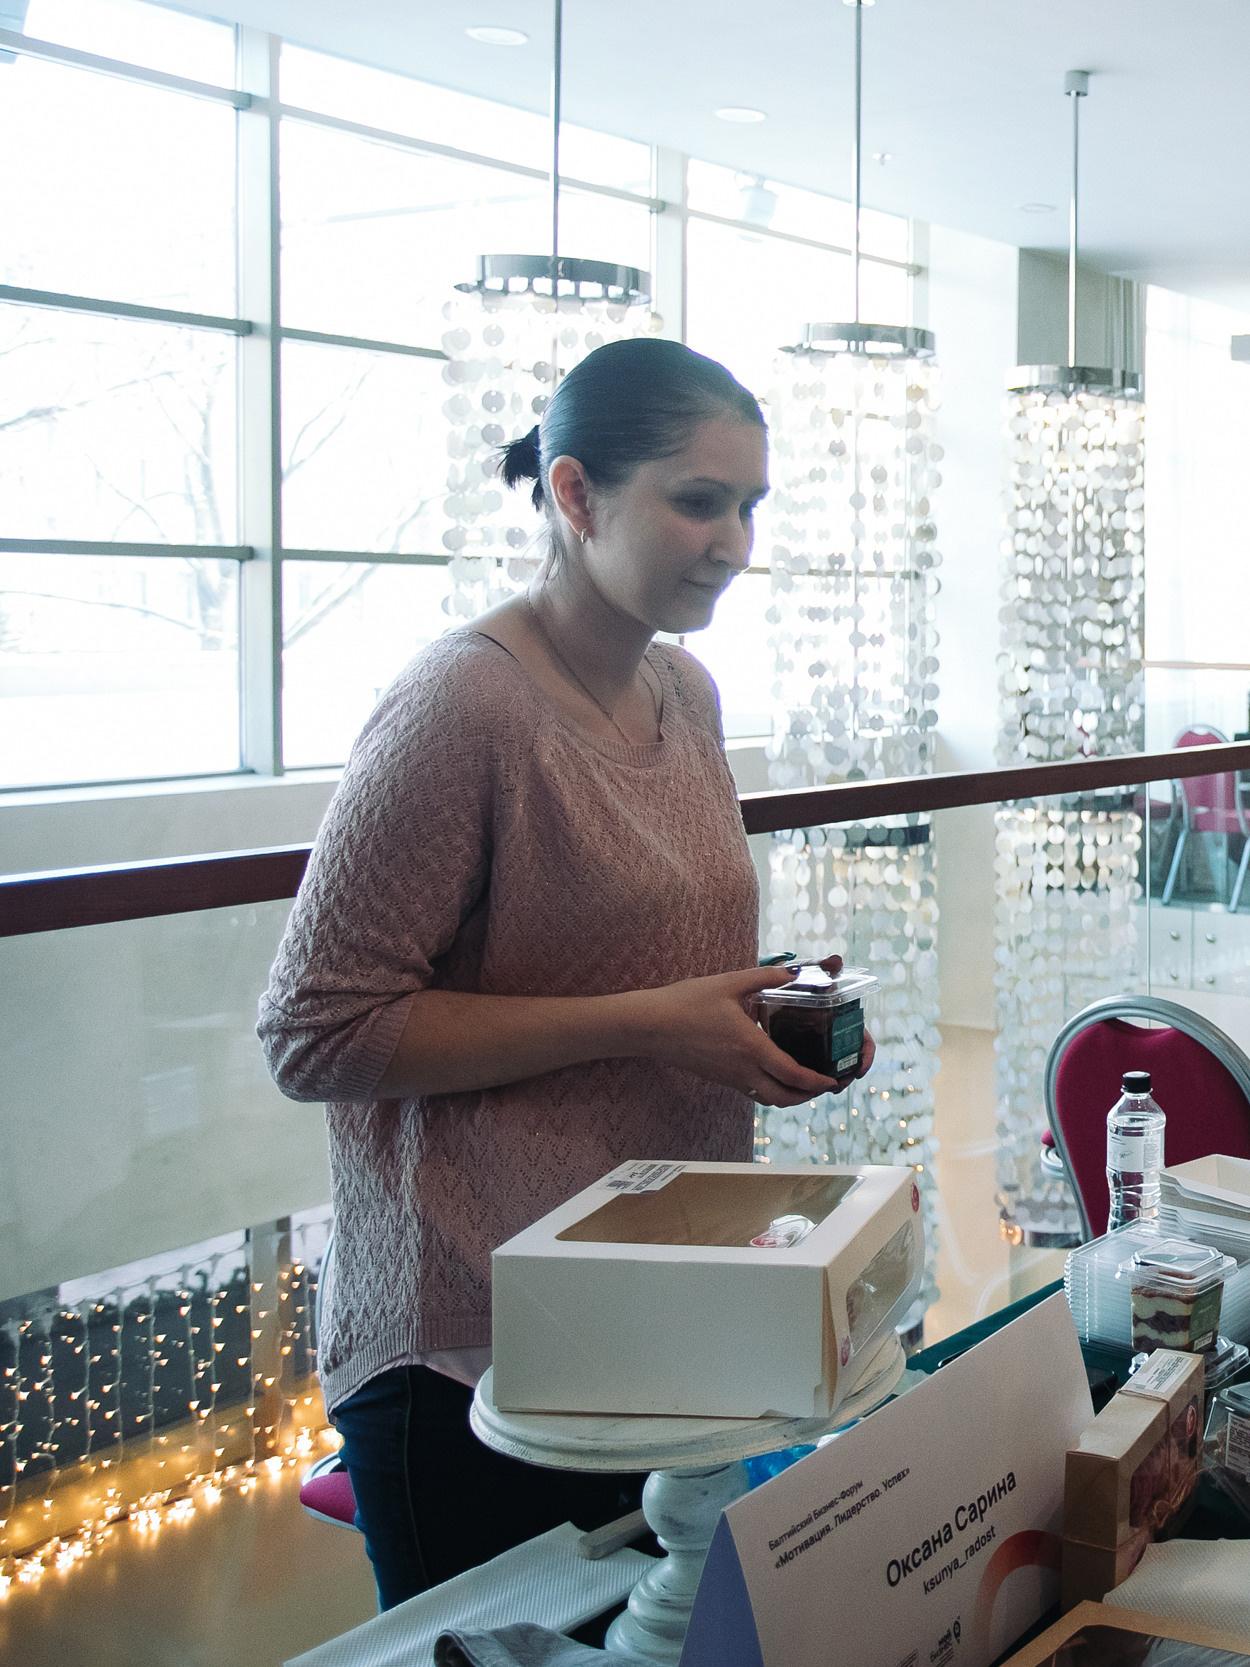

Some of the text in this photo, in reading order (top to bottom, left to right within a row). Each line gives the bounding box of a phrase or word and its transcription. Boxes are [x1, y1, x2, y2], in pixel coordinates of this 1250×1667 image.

[768, 1480, 864, 1551] Балтийский Бизнес-Форум
[775, 1467, 910, 1569] «Мотивация. Лидерство. Успех»
[886, 1471, 1017, 1587] Оксана Сарина
[922, 1524, 996, 1595] ksunya_radost
